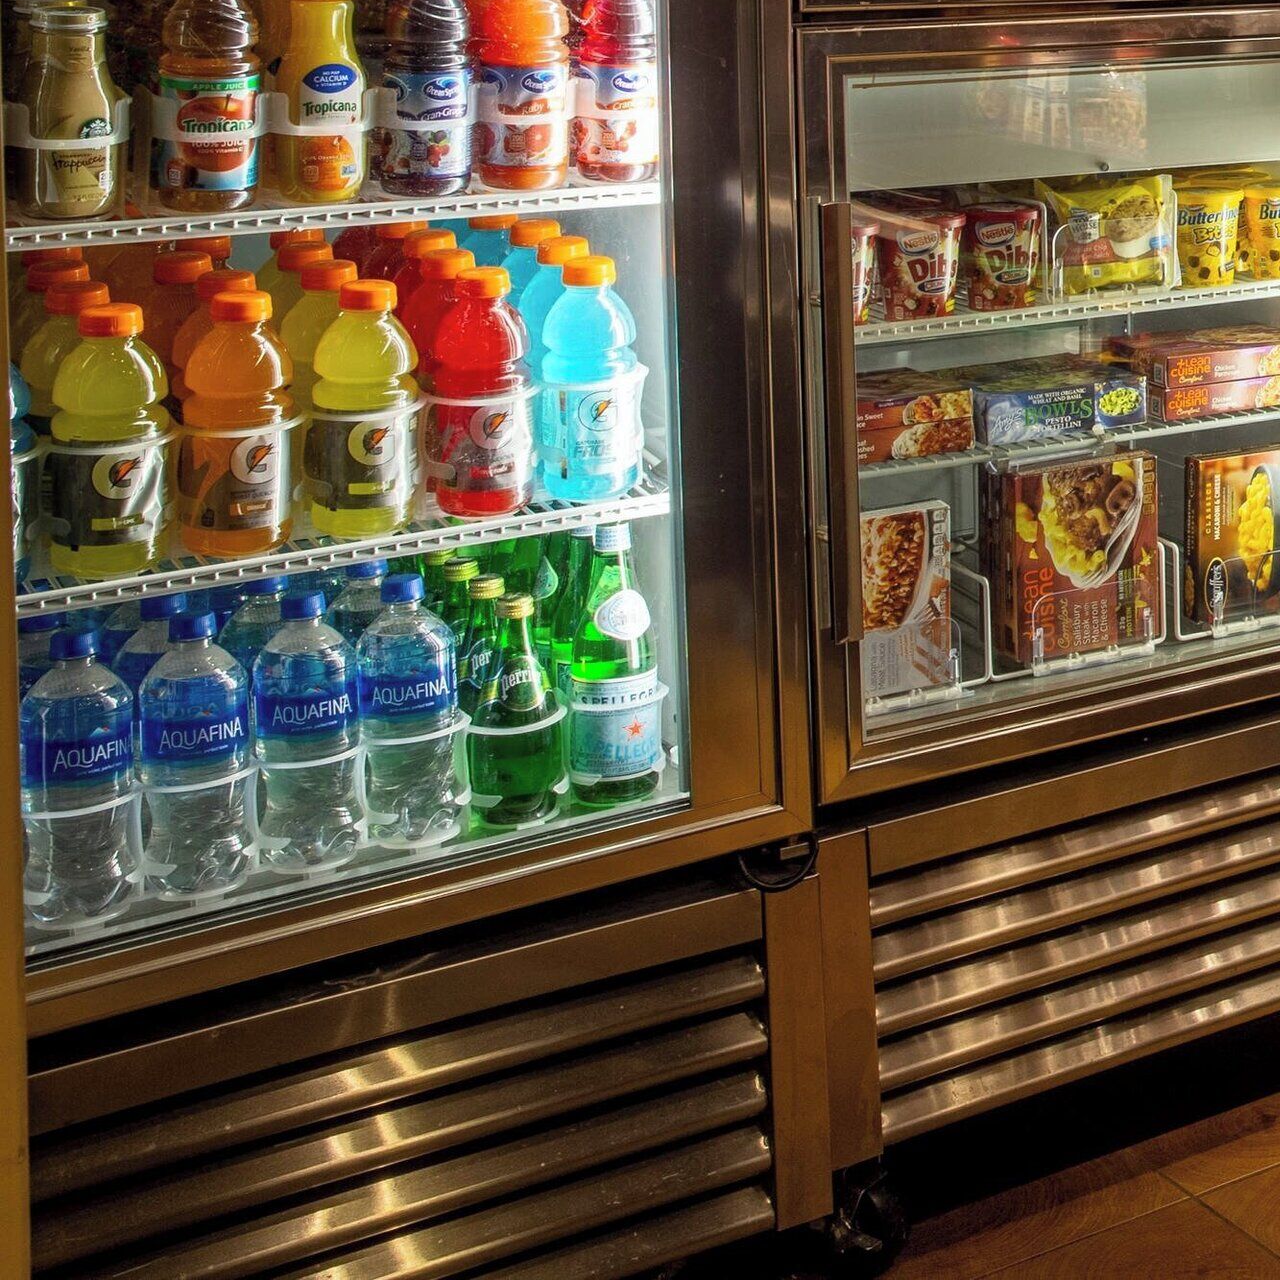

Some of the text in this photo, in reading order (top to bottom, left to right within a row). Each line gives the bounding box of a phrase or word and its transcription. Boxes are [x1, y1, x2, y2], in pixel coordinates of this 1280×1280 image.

[313, 74, 349, 83] CALCIUM
[303, 100, 357, 117] Tropicana
[1170, 365, 1211, 378] cuisine
[1027, 387, 1087, 401] MADE WITH ORGANIC
[1024, 398, 1093, 426] BOWLS
[1045, 415, 1072, 425] PESTO
[1073, 604, 1083, 647] Salisbury
[1091, 601, 1099, 643] Macaroni
[372, 679, 450, 707] AQUAFINA
[272, 693, 352, 727] AQUAFINA
[159, 716, 244, 751] AQUAFINA
